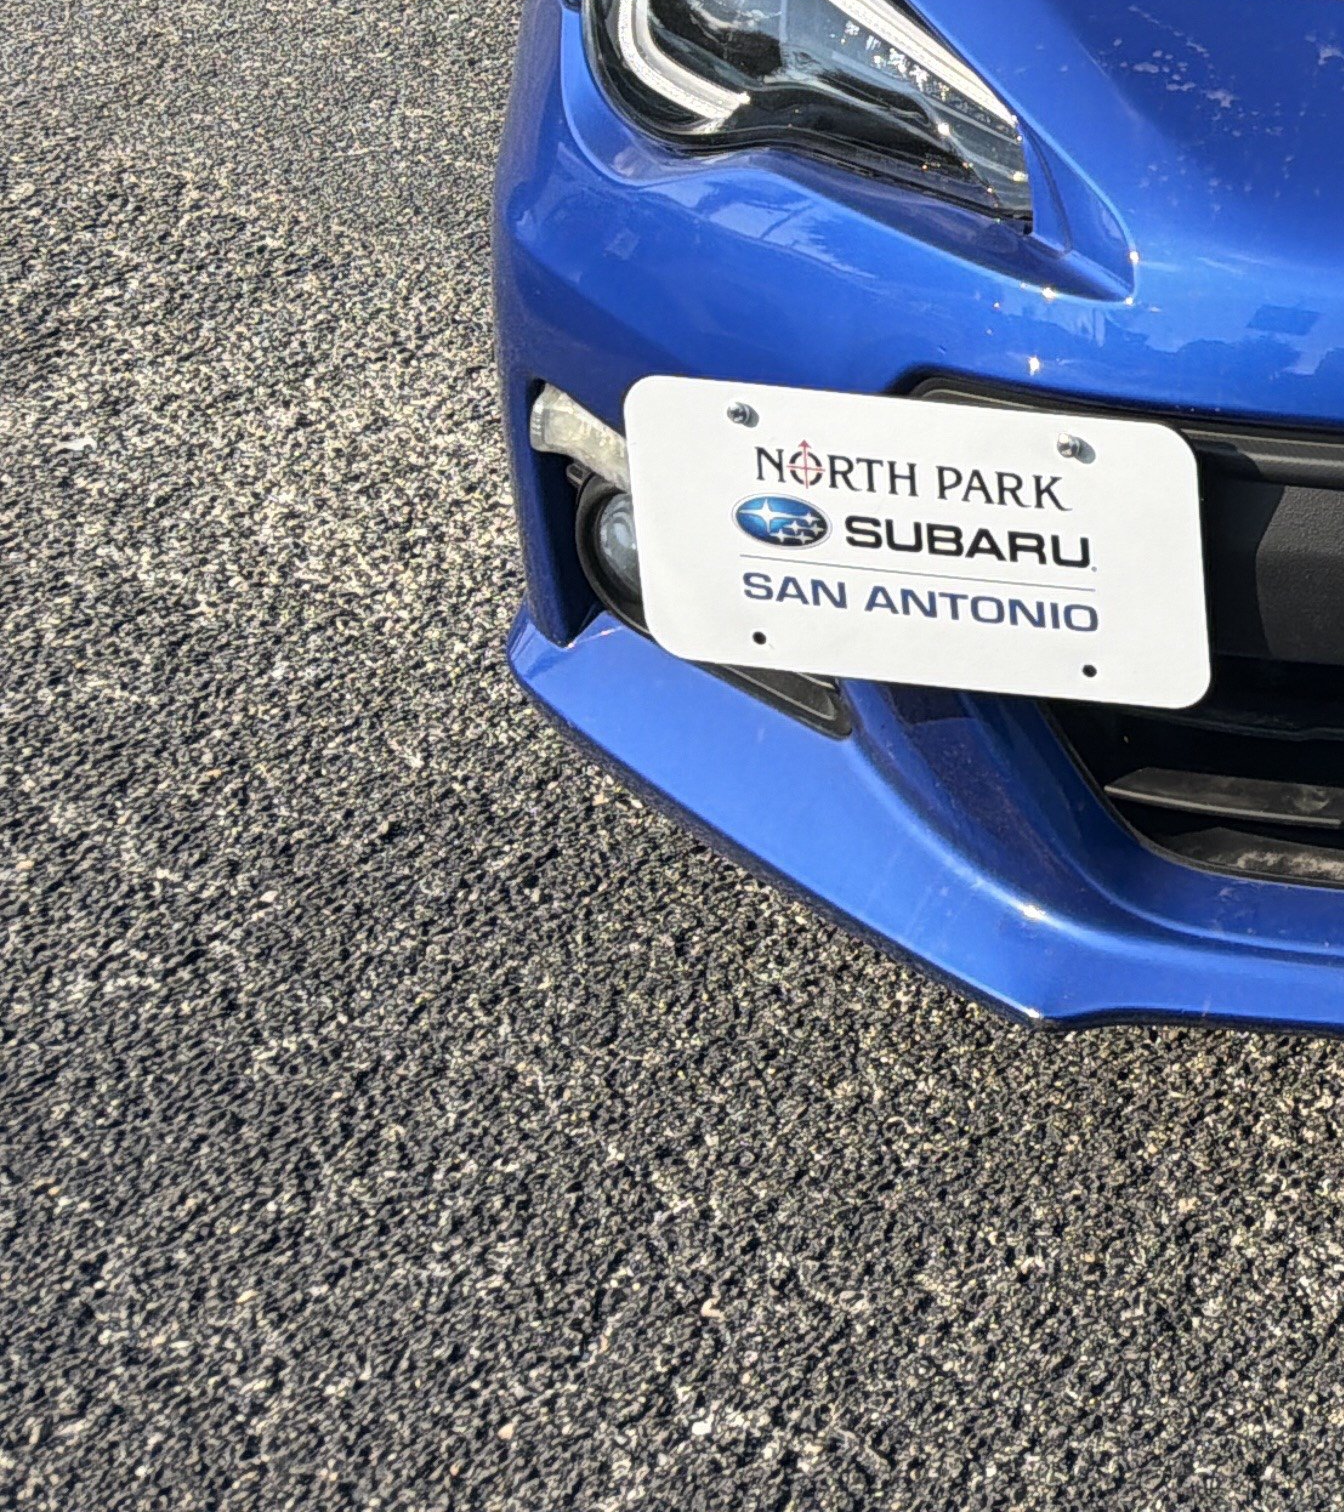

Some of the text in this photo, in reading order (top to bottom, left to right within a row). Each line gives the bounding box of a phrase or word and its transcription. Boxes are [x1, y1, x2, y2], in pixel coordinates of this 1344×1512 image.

[755, 444, 1072, 512] NORTH PARK
[845, 515, 1091, 569] SUBARU
[742, 571, 1099, 633] SAN ANTONIO
